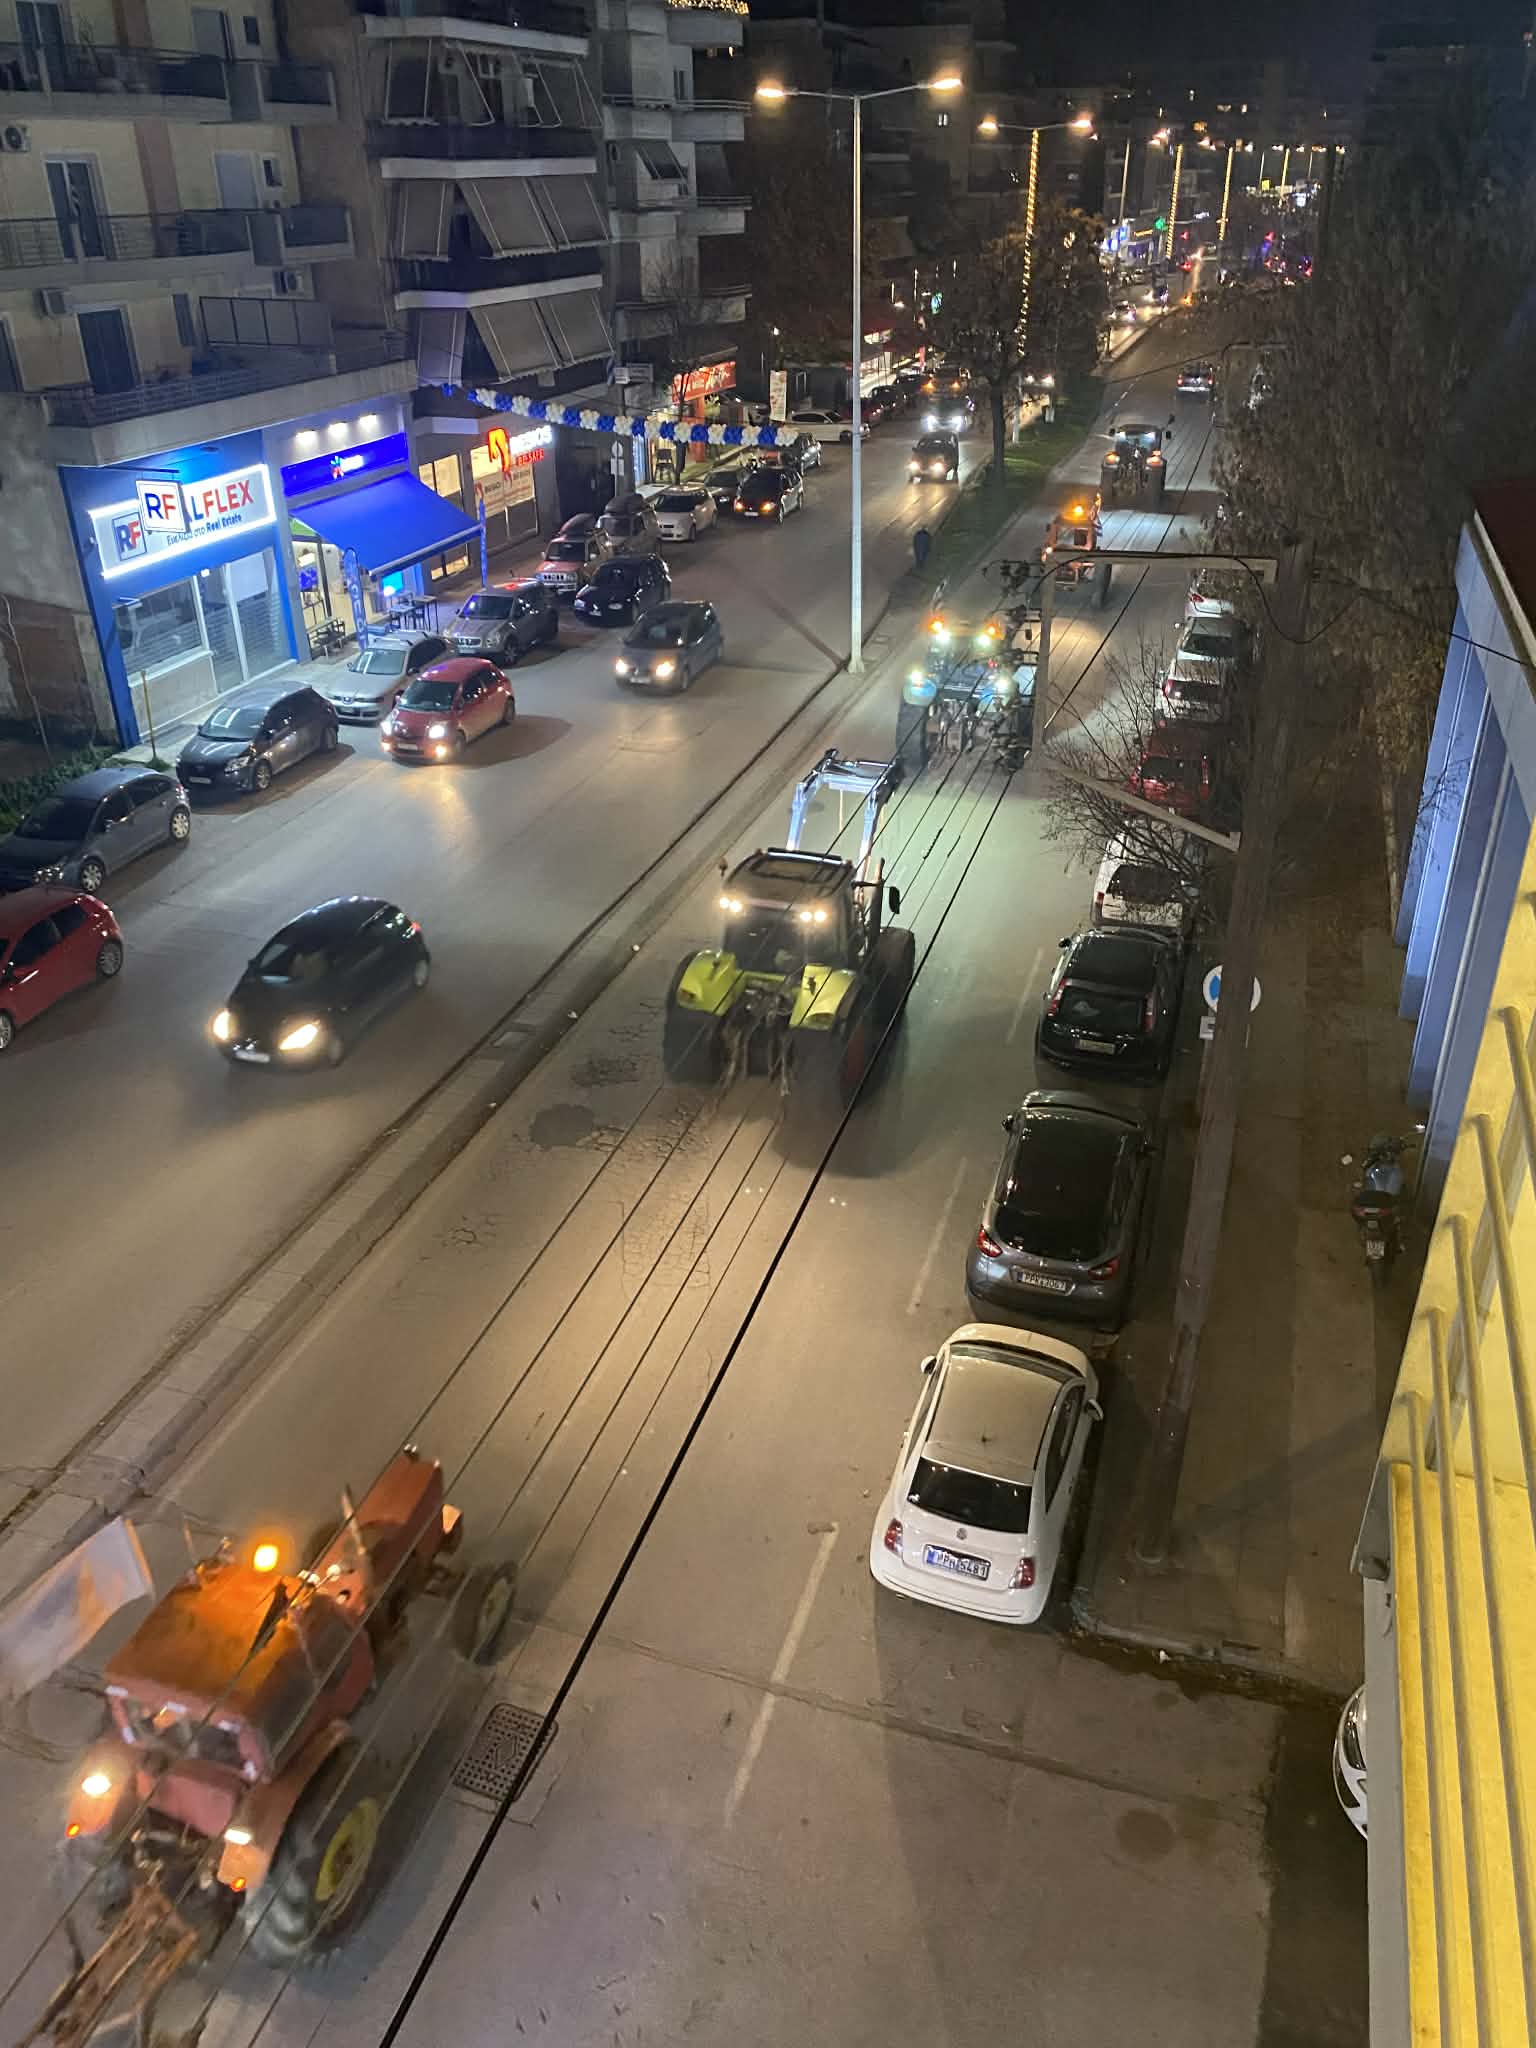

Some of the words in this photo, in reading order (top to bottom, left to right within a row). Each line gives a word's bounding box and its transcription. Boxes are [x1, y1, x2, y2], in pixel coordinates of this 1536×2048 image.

[144, 492, 177, 521] RF
[116, 520, 142, 551] RF
[206, 518, 222, 533] Real
[222, 512, 243, 528] Estate
